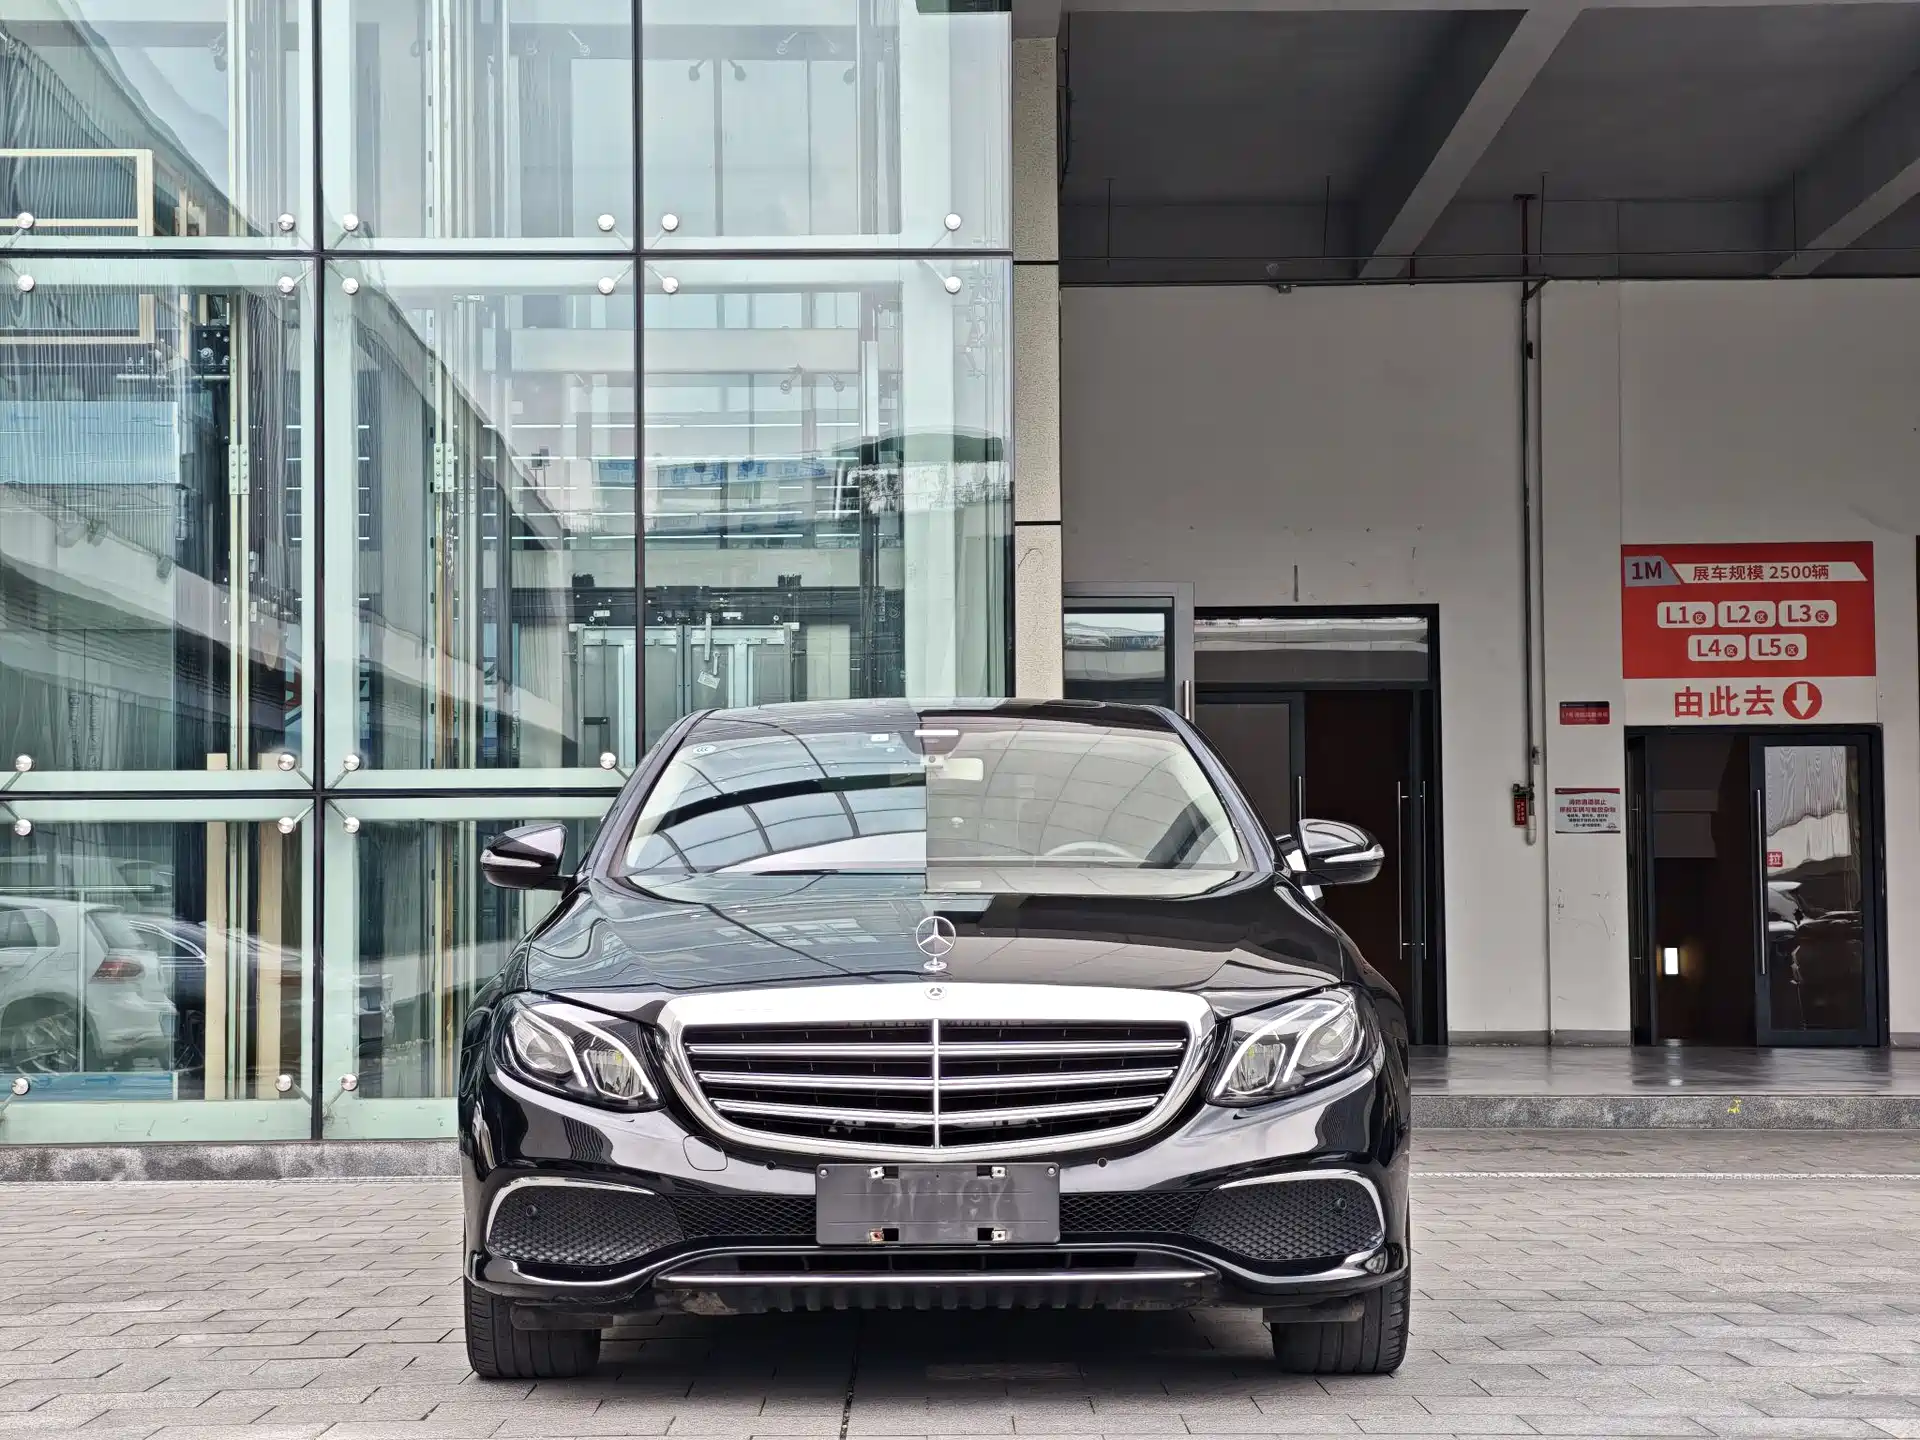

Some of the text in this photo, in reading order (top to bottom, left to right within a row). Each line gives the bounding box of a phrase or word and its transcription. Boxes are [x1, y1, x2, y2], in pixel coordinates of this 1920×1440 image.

[1631, 561, 1662, 580] 1M
[1693, 564, 1830, 581] 展车规模 2500辆
[1674, 685, 1775, 718] 由此去
